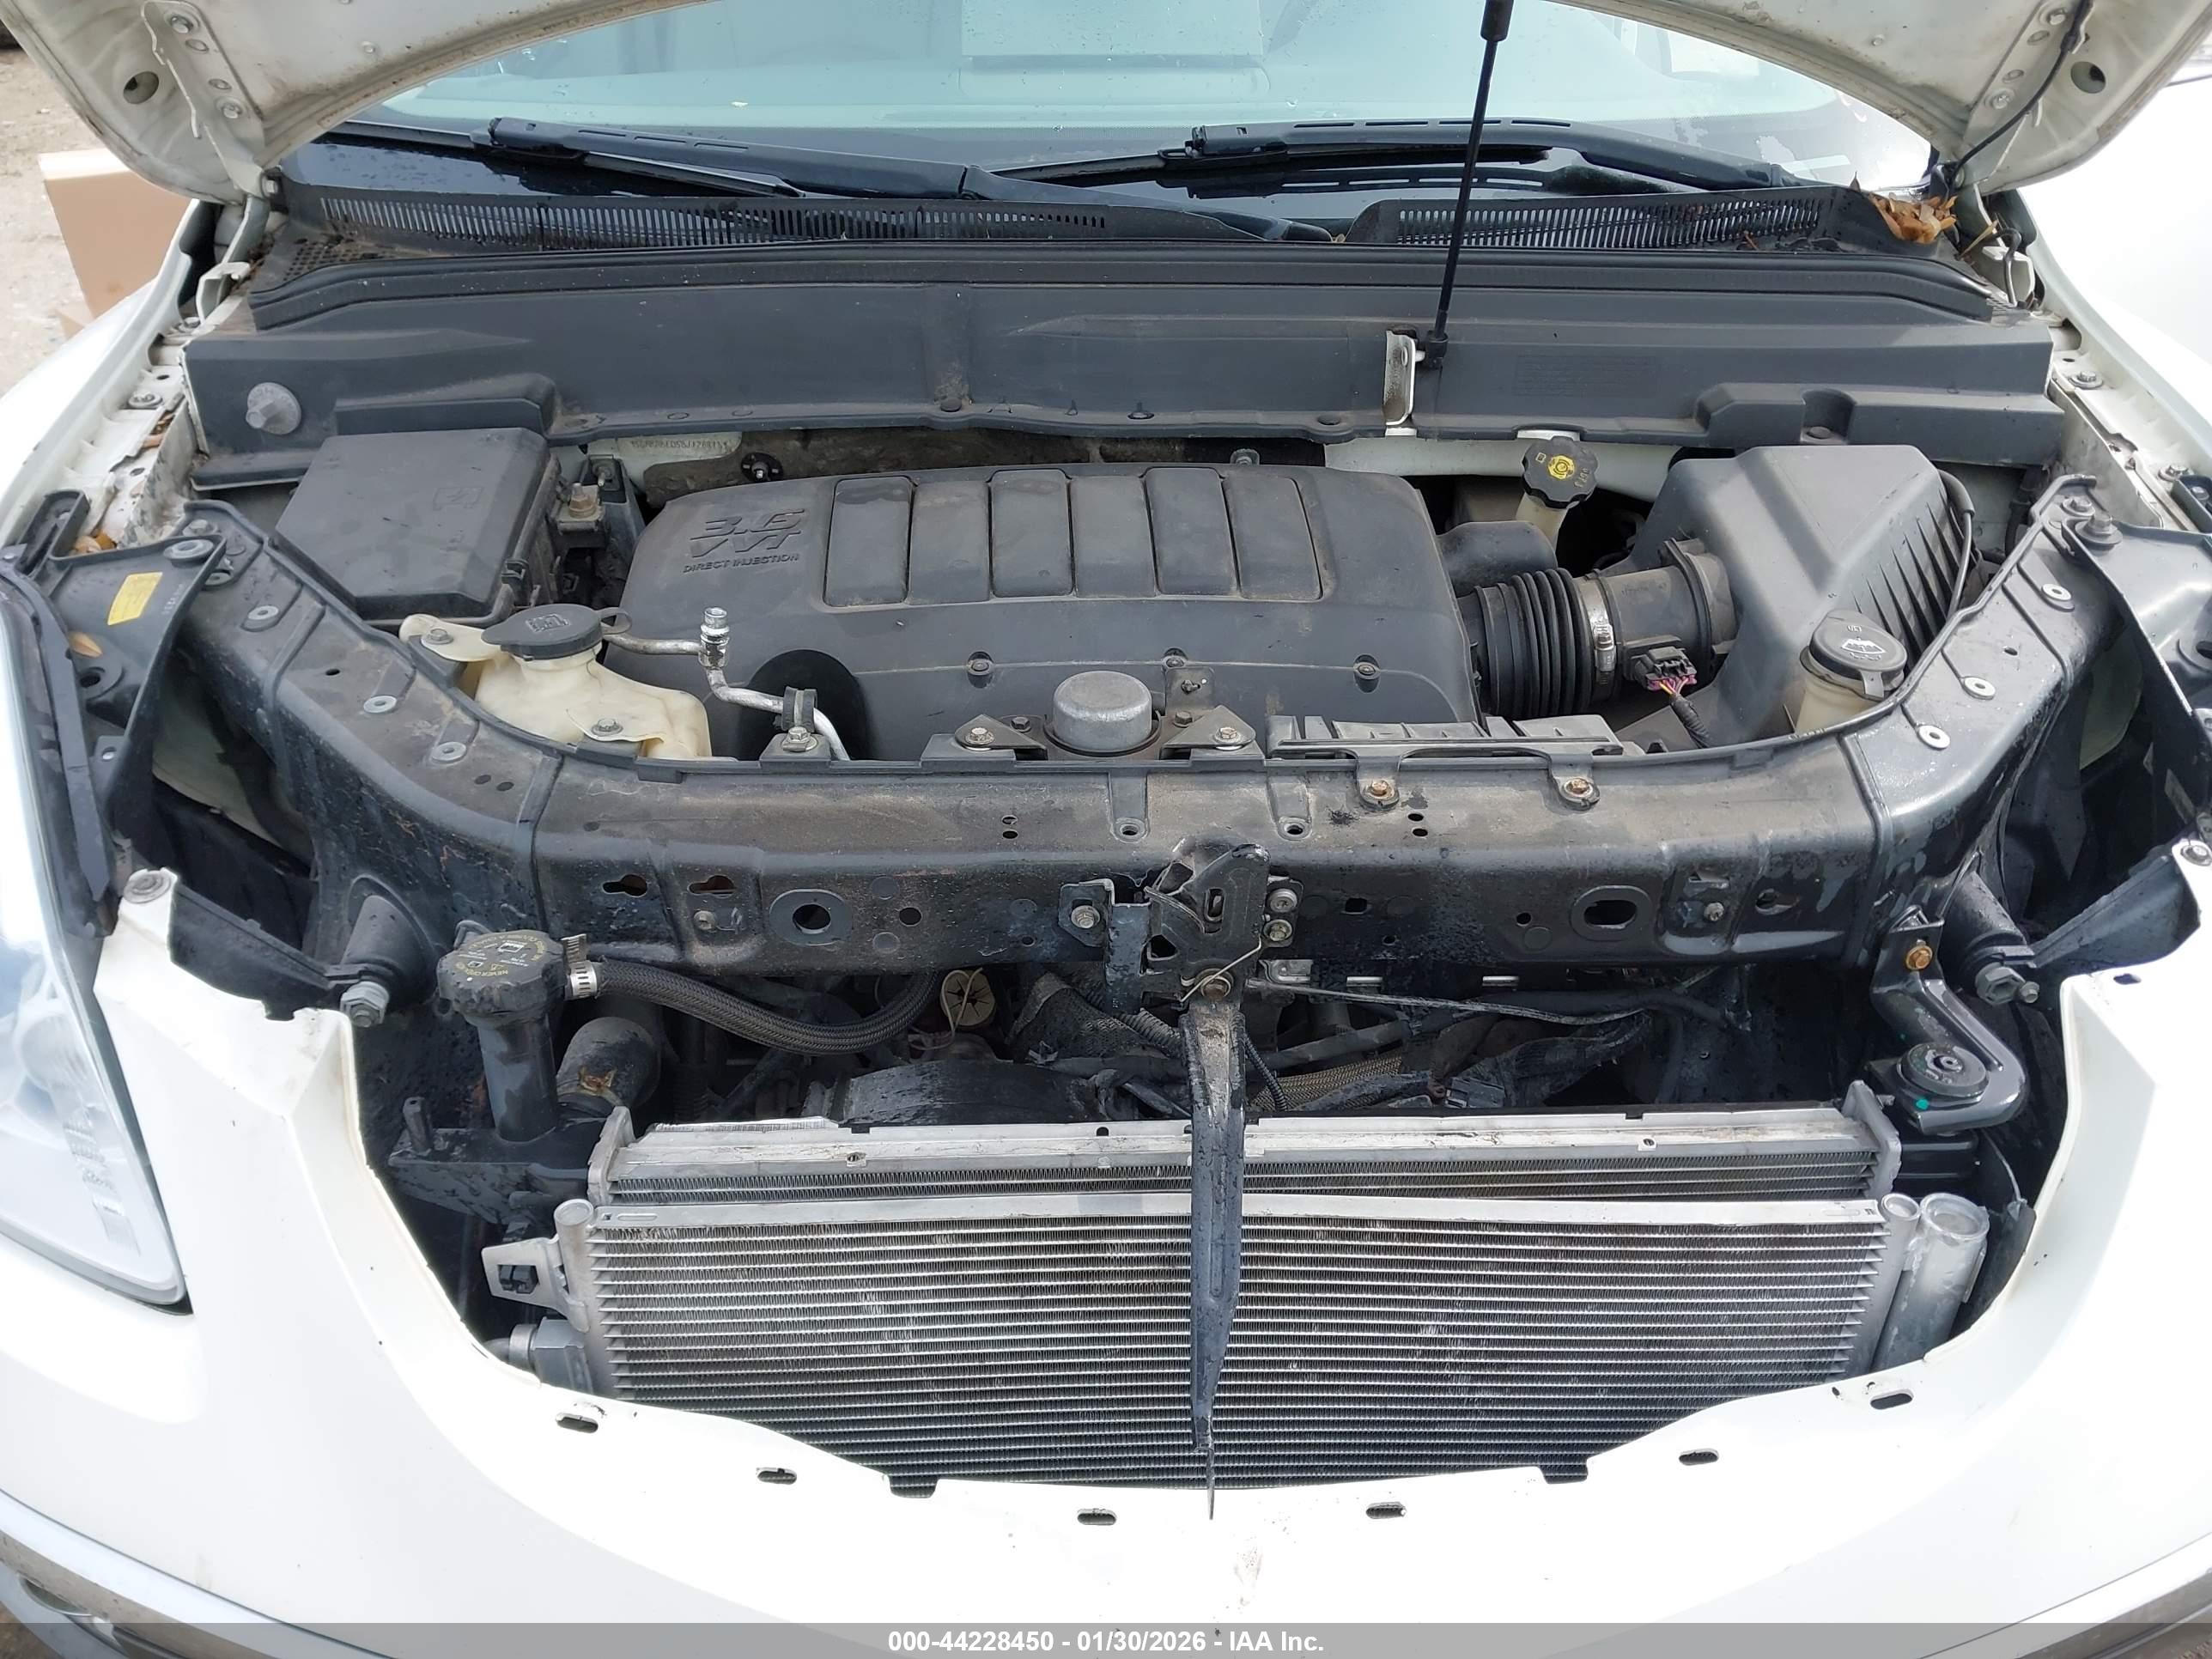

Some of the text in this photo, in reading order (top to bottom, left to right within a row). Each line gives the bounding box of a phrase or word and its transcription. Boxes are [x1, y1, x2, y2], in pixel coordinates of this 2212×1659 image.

[689, 508, 805, 541] 3.6
[687, 530, 802, 559] VVT
[683, 553, 800, 574] DIRECT INJECTION
